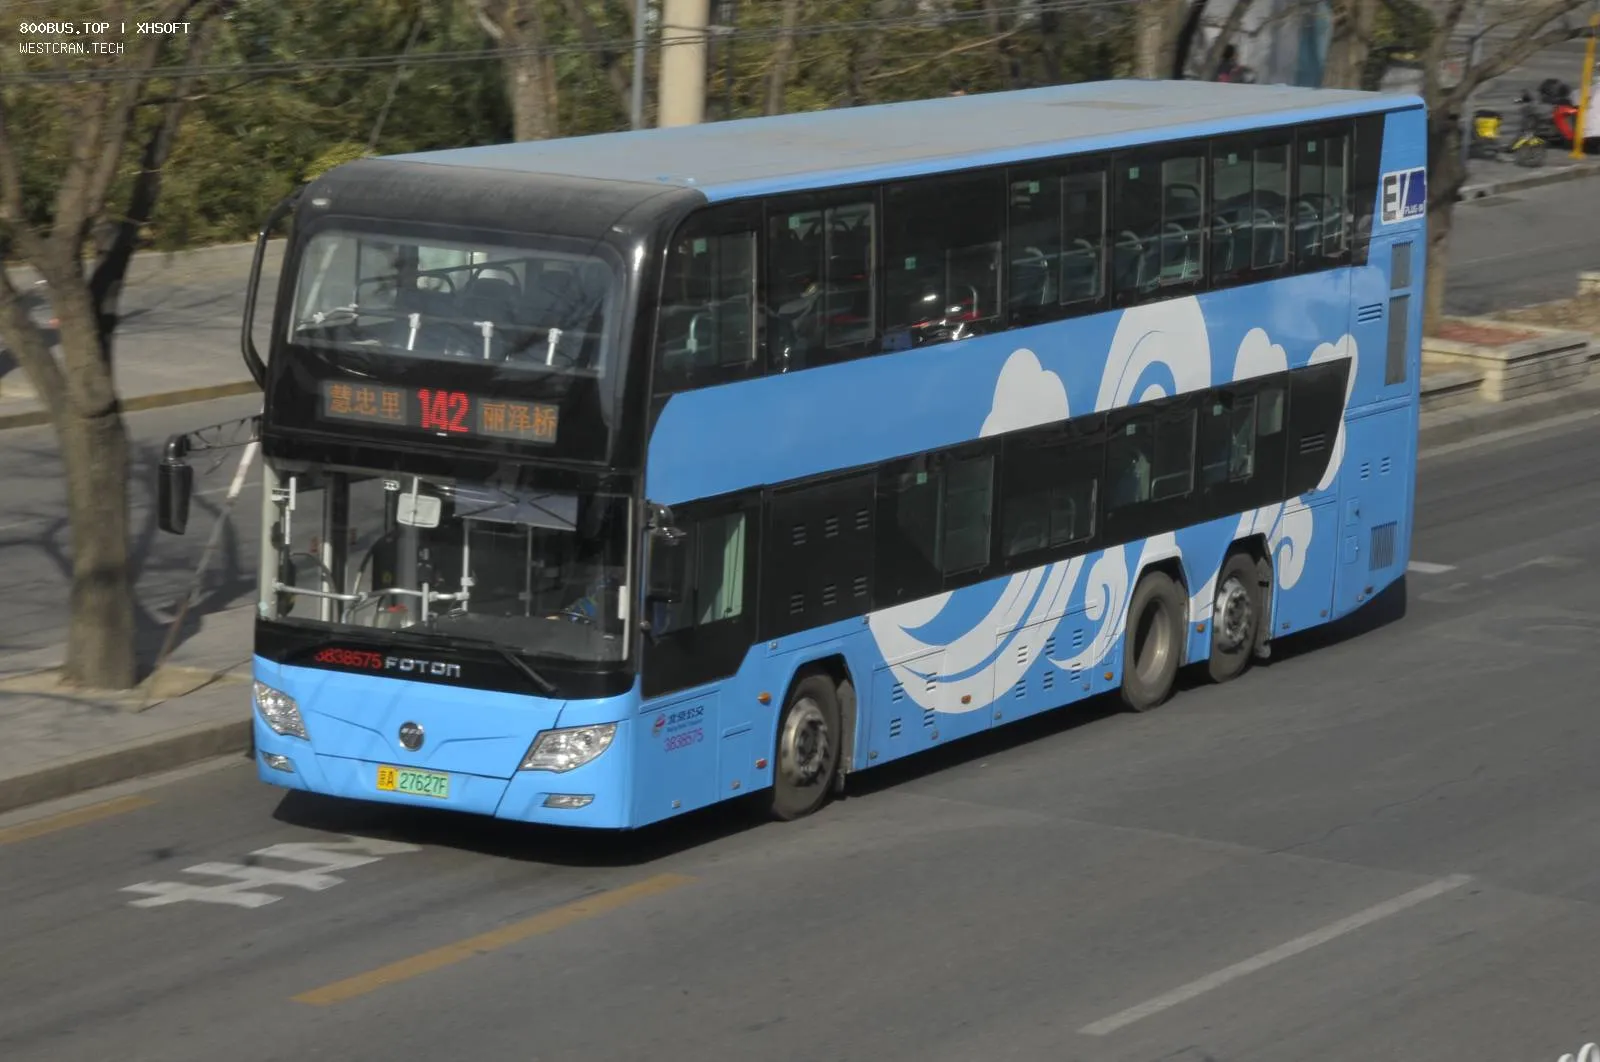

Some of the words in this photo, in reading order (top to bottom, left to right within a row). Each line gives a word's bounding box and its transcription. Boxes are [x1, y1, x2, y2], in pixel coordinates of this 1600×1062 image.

[329, 383, 402, 420] 慧忠里
[417, 388, 469, 433] 142
[482, 402, 556, 437] 丽泽桥
[314, 648, 383, 669] 3838575
[385, 656, 461, 678] FOTON
